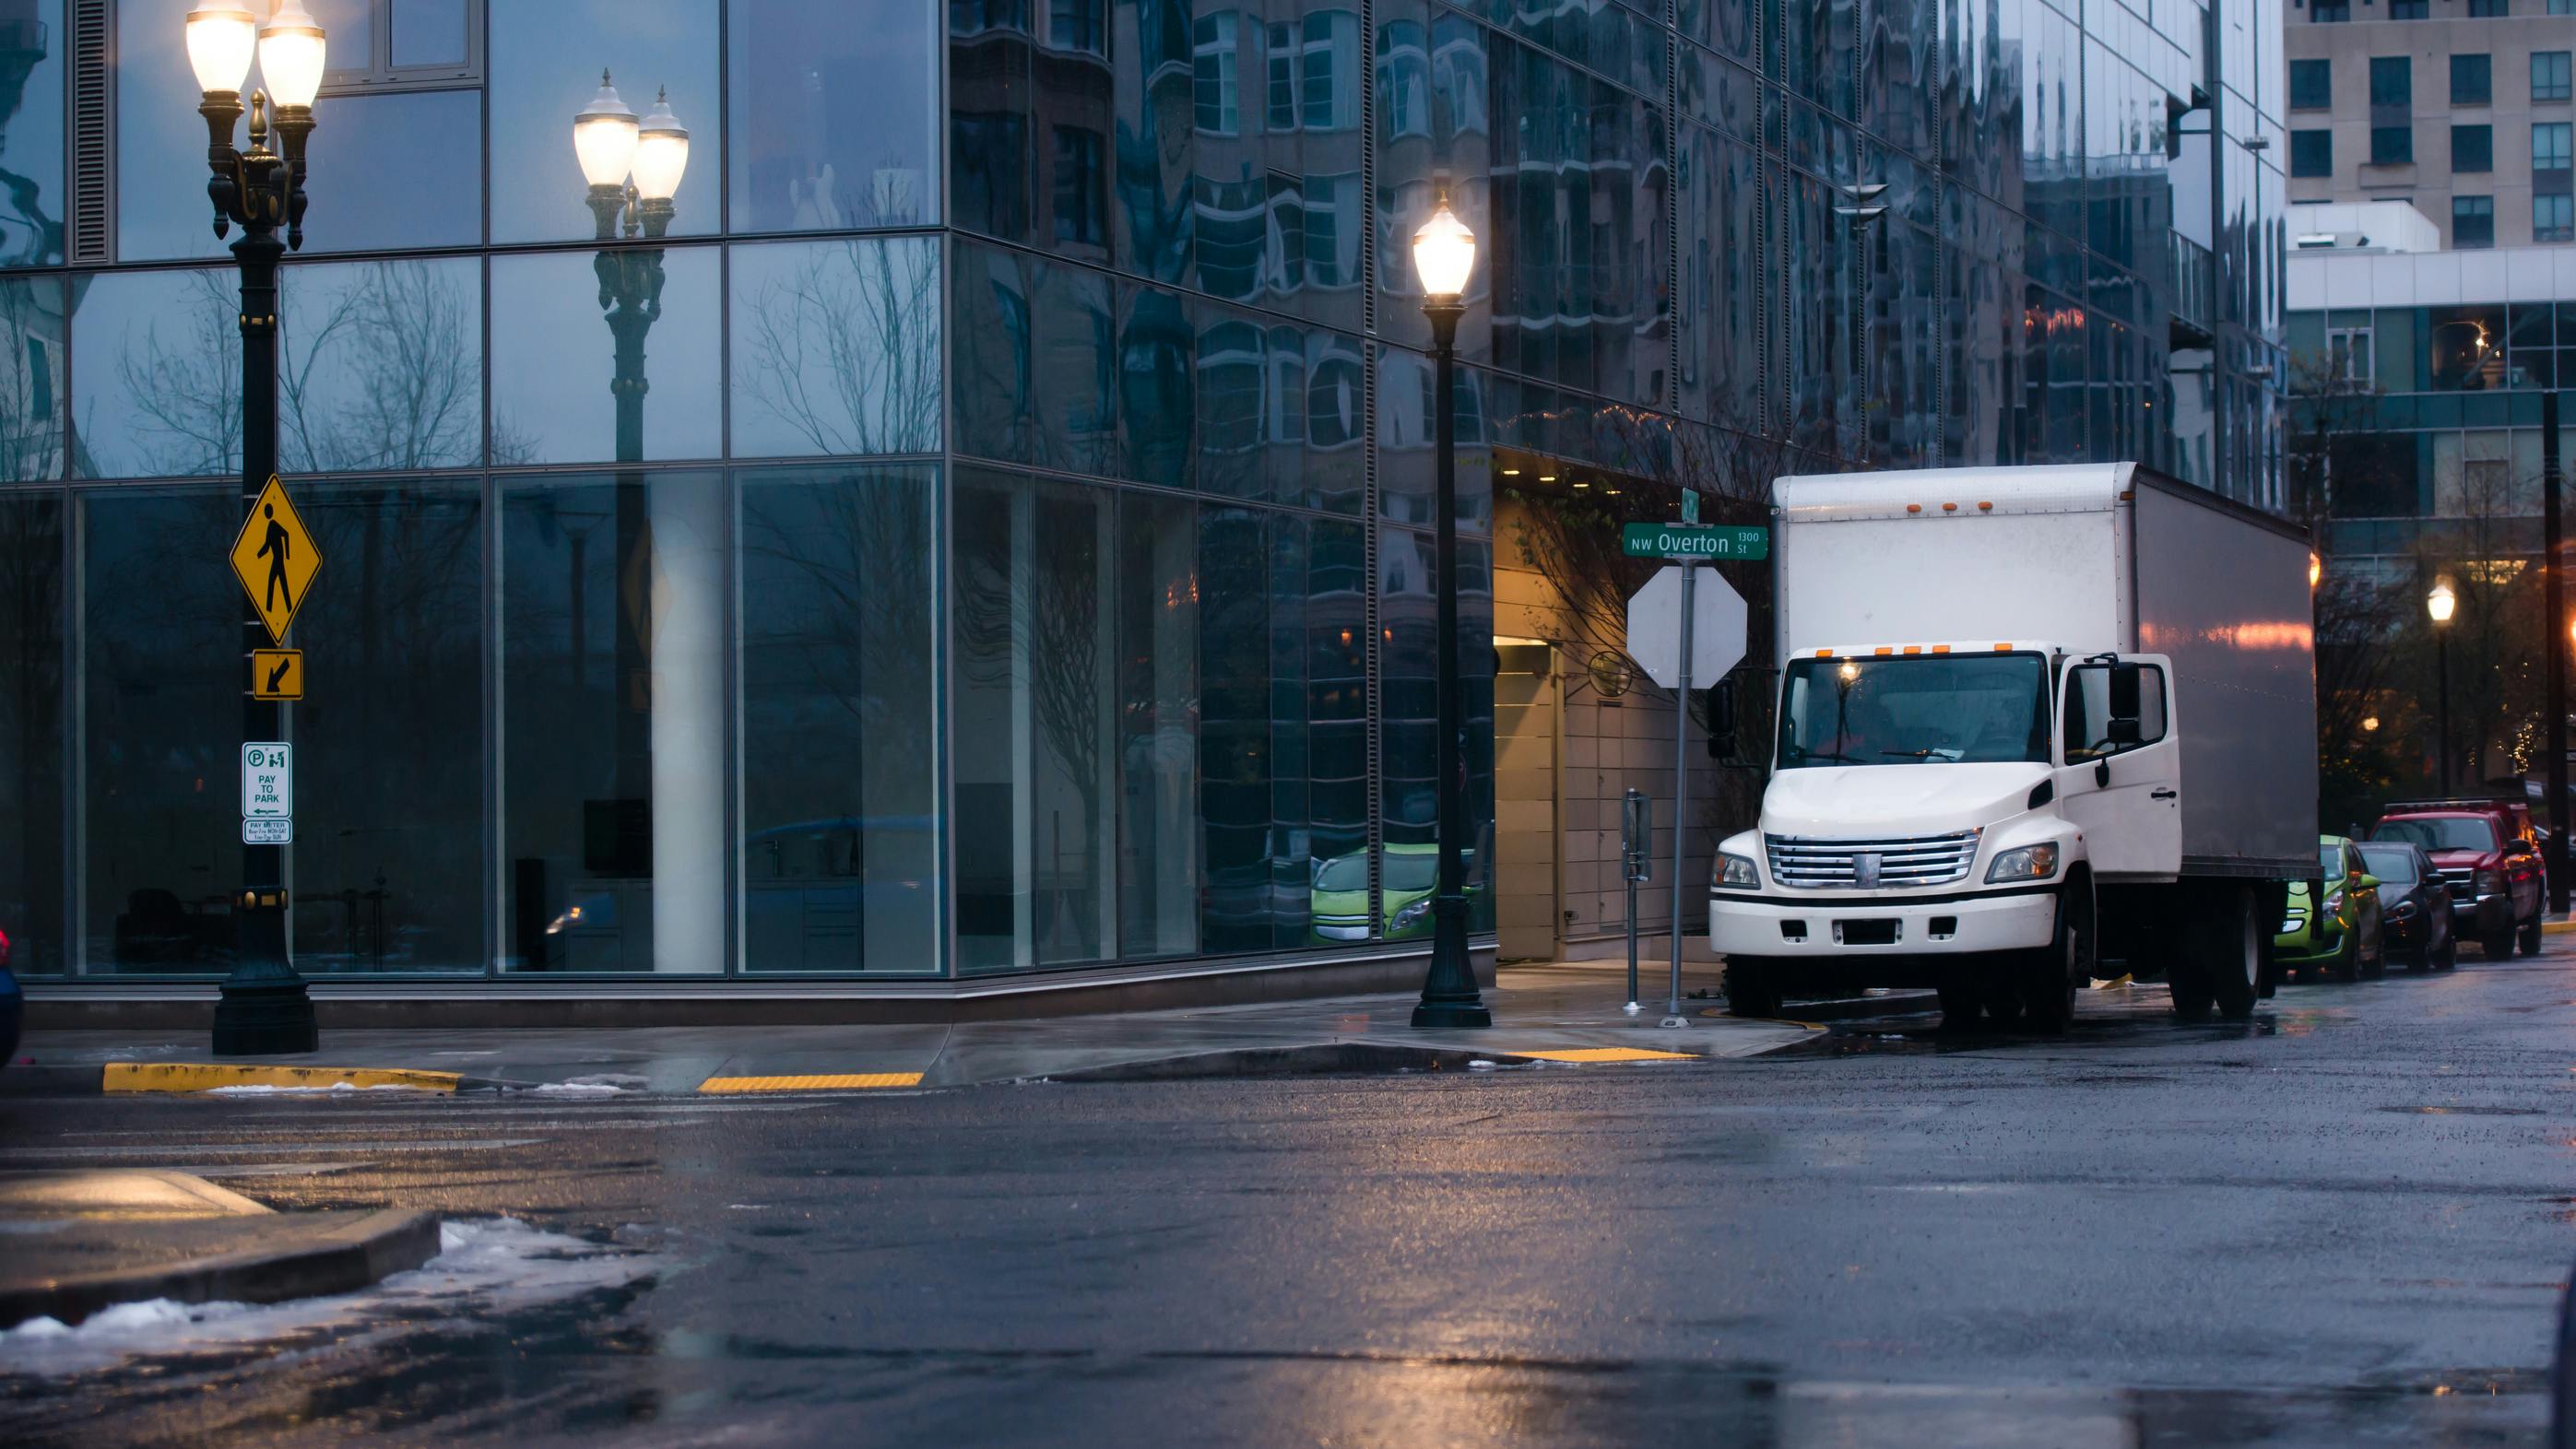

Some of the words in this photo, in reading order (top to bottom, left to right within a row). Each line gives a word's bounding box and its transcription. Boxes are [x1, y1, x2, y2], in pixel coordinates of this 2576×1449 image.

[1632, 537, 1652, 550] NW
[1659, 534, 1729, 553] Overton
[1738, 532, 1759, 542] 1300
[1738, 544, 1747, 554] St
[253, 753, 261, 764] P
[259, 775, 276, 783] PAY
[261, 784, 273, 794] TO
[254, 795, 279, 803] PARK
